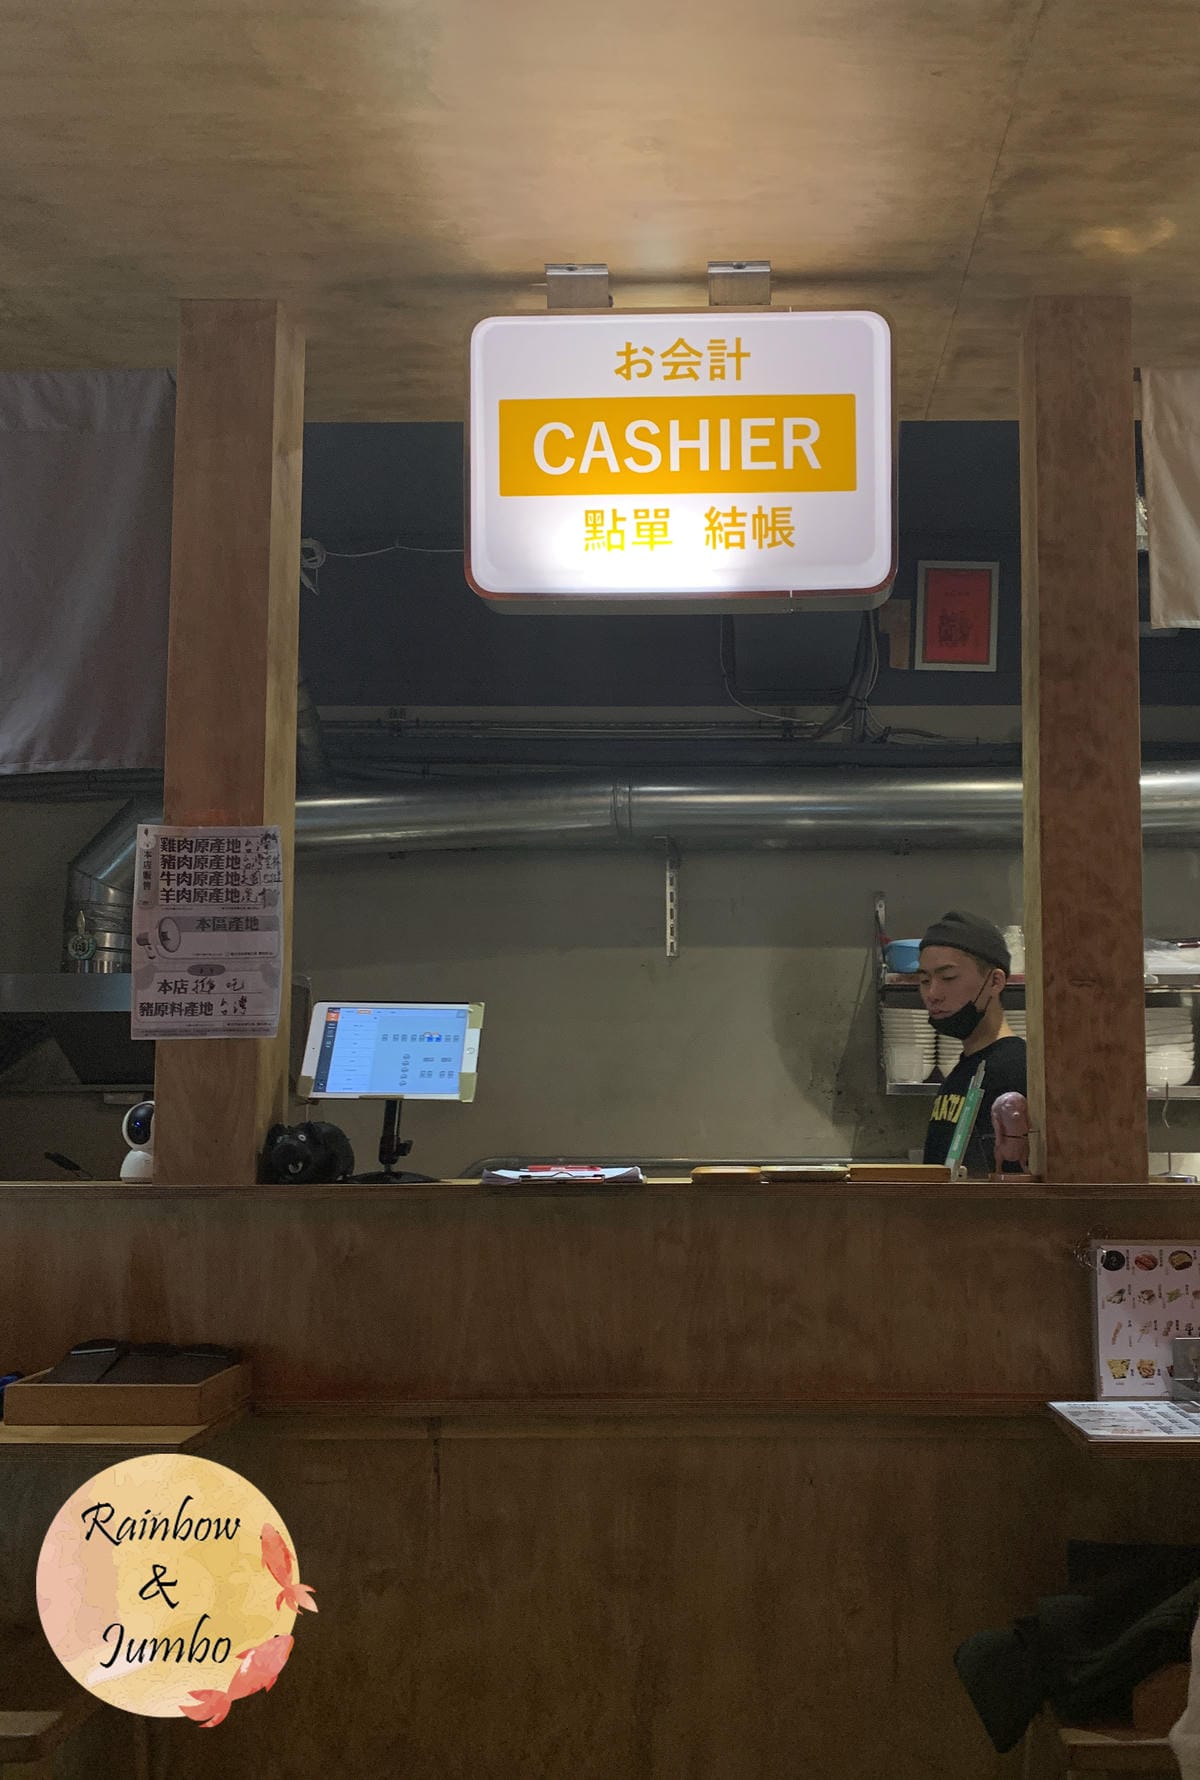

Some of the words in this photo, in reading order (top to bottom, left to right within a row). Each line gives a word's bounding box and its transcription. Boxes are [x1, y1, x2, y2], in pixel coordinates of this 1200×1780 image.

[613, 336, 751, 381] お会計
[532, 417, 822, 475] CASHIER
[583, 507, 674, 552] 點單
[703, 505, 796, 550] 結帳
[160, 837, 241, 853] 雞肉原產地
[160, 855, 241, 870] 豬肉原產地
[160, 871, 240, 887] 牛肉原產地
[160, 888, 240, 904] 羊肉原產地
[196, 916, 259, 931] 本區產地
[157, 979, 189, 994] 本店
[139, 1002, 214, 1017] 豬原料產地
